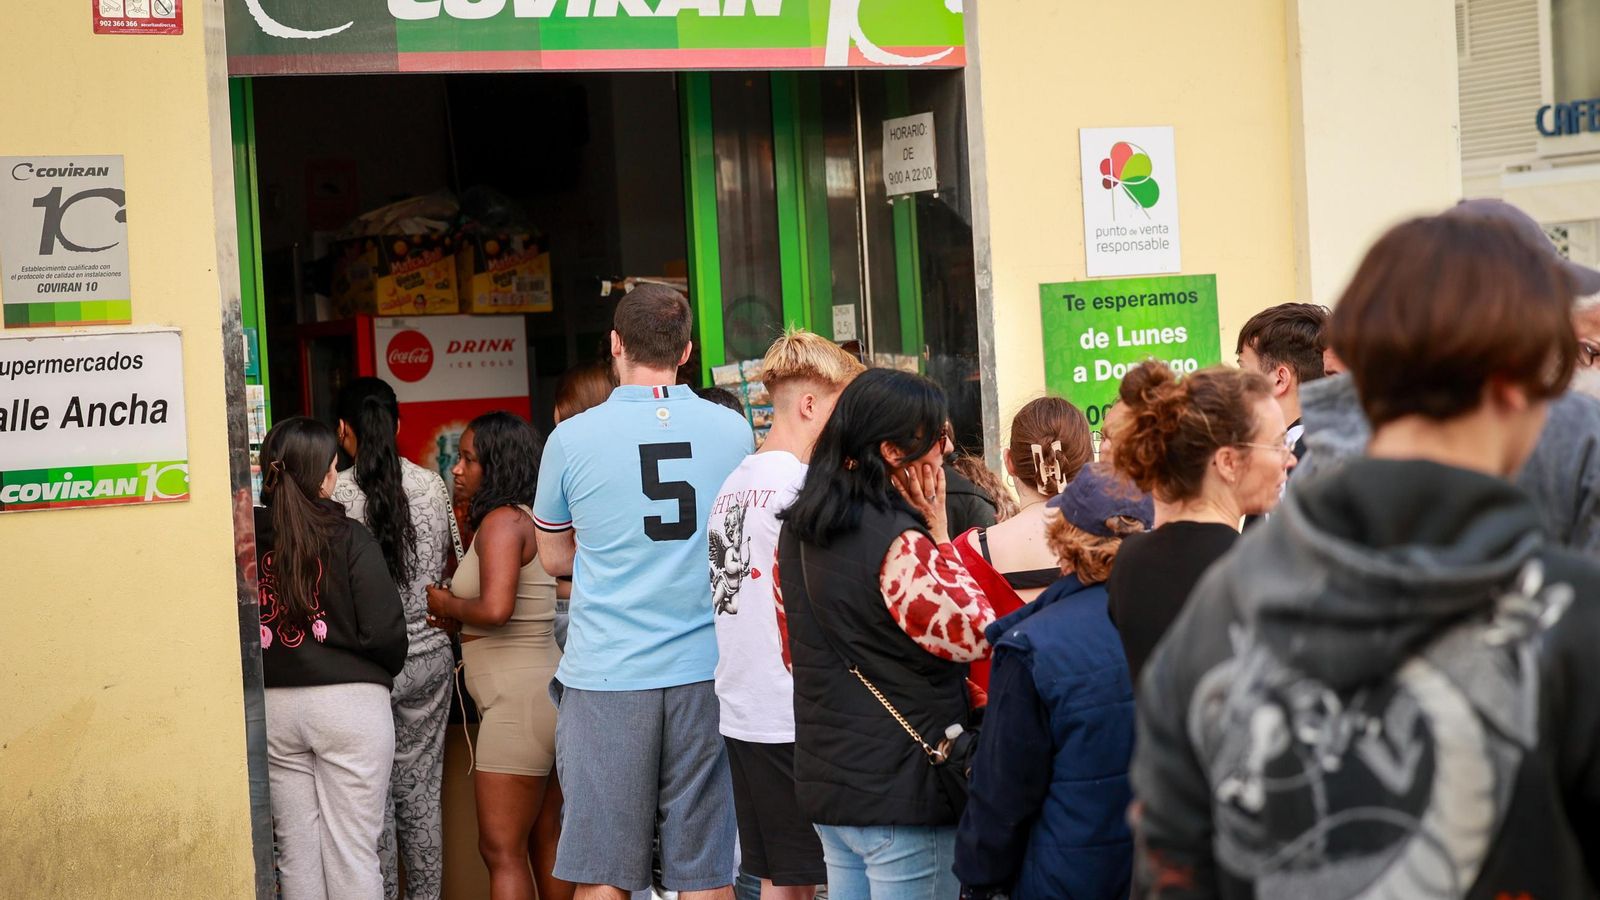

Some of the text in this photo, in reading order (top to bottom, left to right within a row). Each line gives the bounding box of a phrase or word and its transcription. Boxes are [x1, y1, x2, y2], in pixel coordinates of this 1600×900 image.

[890, 123, 928, 141] HORARIO:
[903, 147, 914, 161] DE
[35, 162, 109, 178] COVIRAN
[905, 170, 911, 182] A
[1095, 225, 1127, 240] punto
[1139, 224, 1169, 235] venta
[1096, 238, 1170, 254] responsable
[17, 272, 45, 281] protocolo
[53, 271, 76, 279] calidad
[84, 270, 122, 278] instalaciones
[21, 264, 67, 273] Establecimiento
[67, 263, 99, 271] cualificado
[37, 281, 98, 293] COVIRAN 10
[1062, 289, 1199, 313] Te esperamos
[1079, 325, 1188, 350] de Lunes
[446, 339, 516, 354] DRINK
[0, 351, 144, 381] upermercados
[450, 359, 514, 369] ICE COLD
[1072, 355, 1199, 385] a Dogo
[0, 392, 168, 432] alle Ancha
[0, 471, 138, 503] COVIRAN
[638, 441, 698, 542] 5
